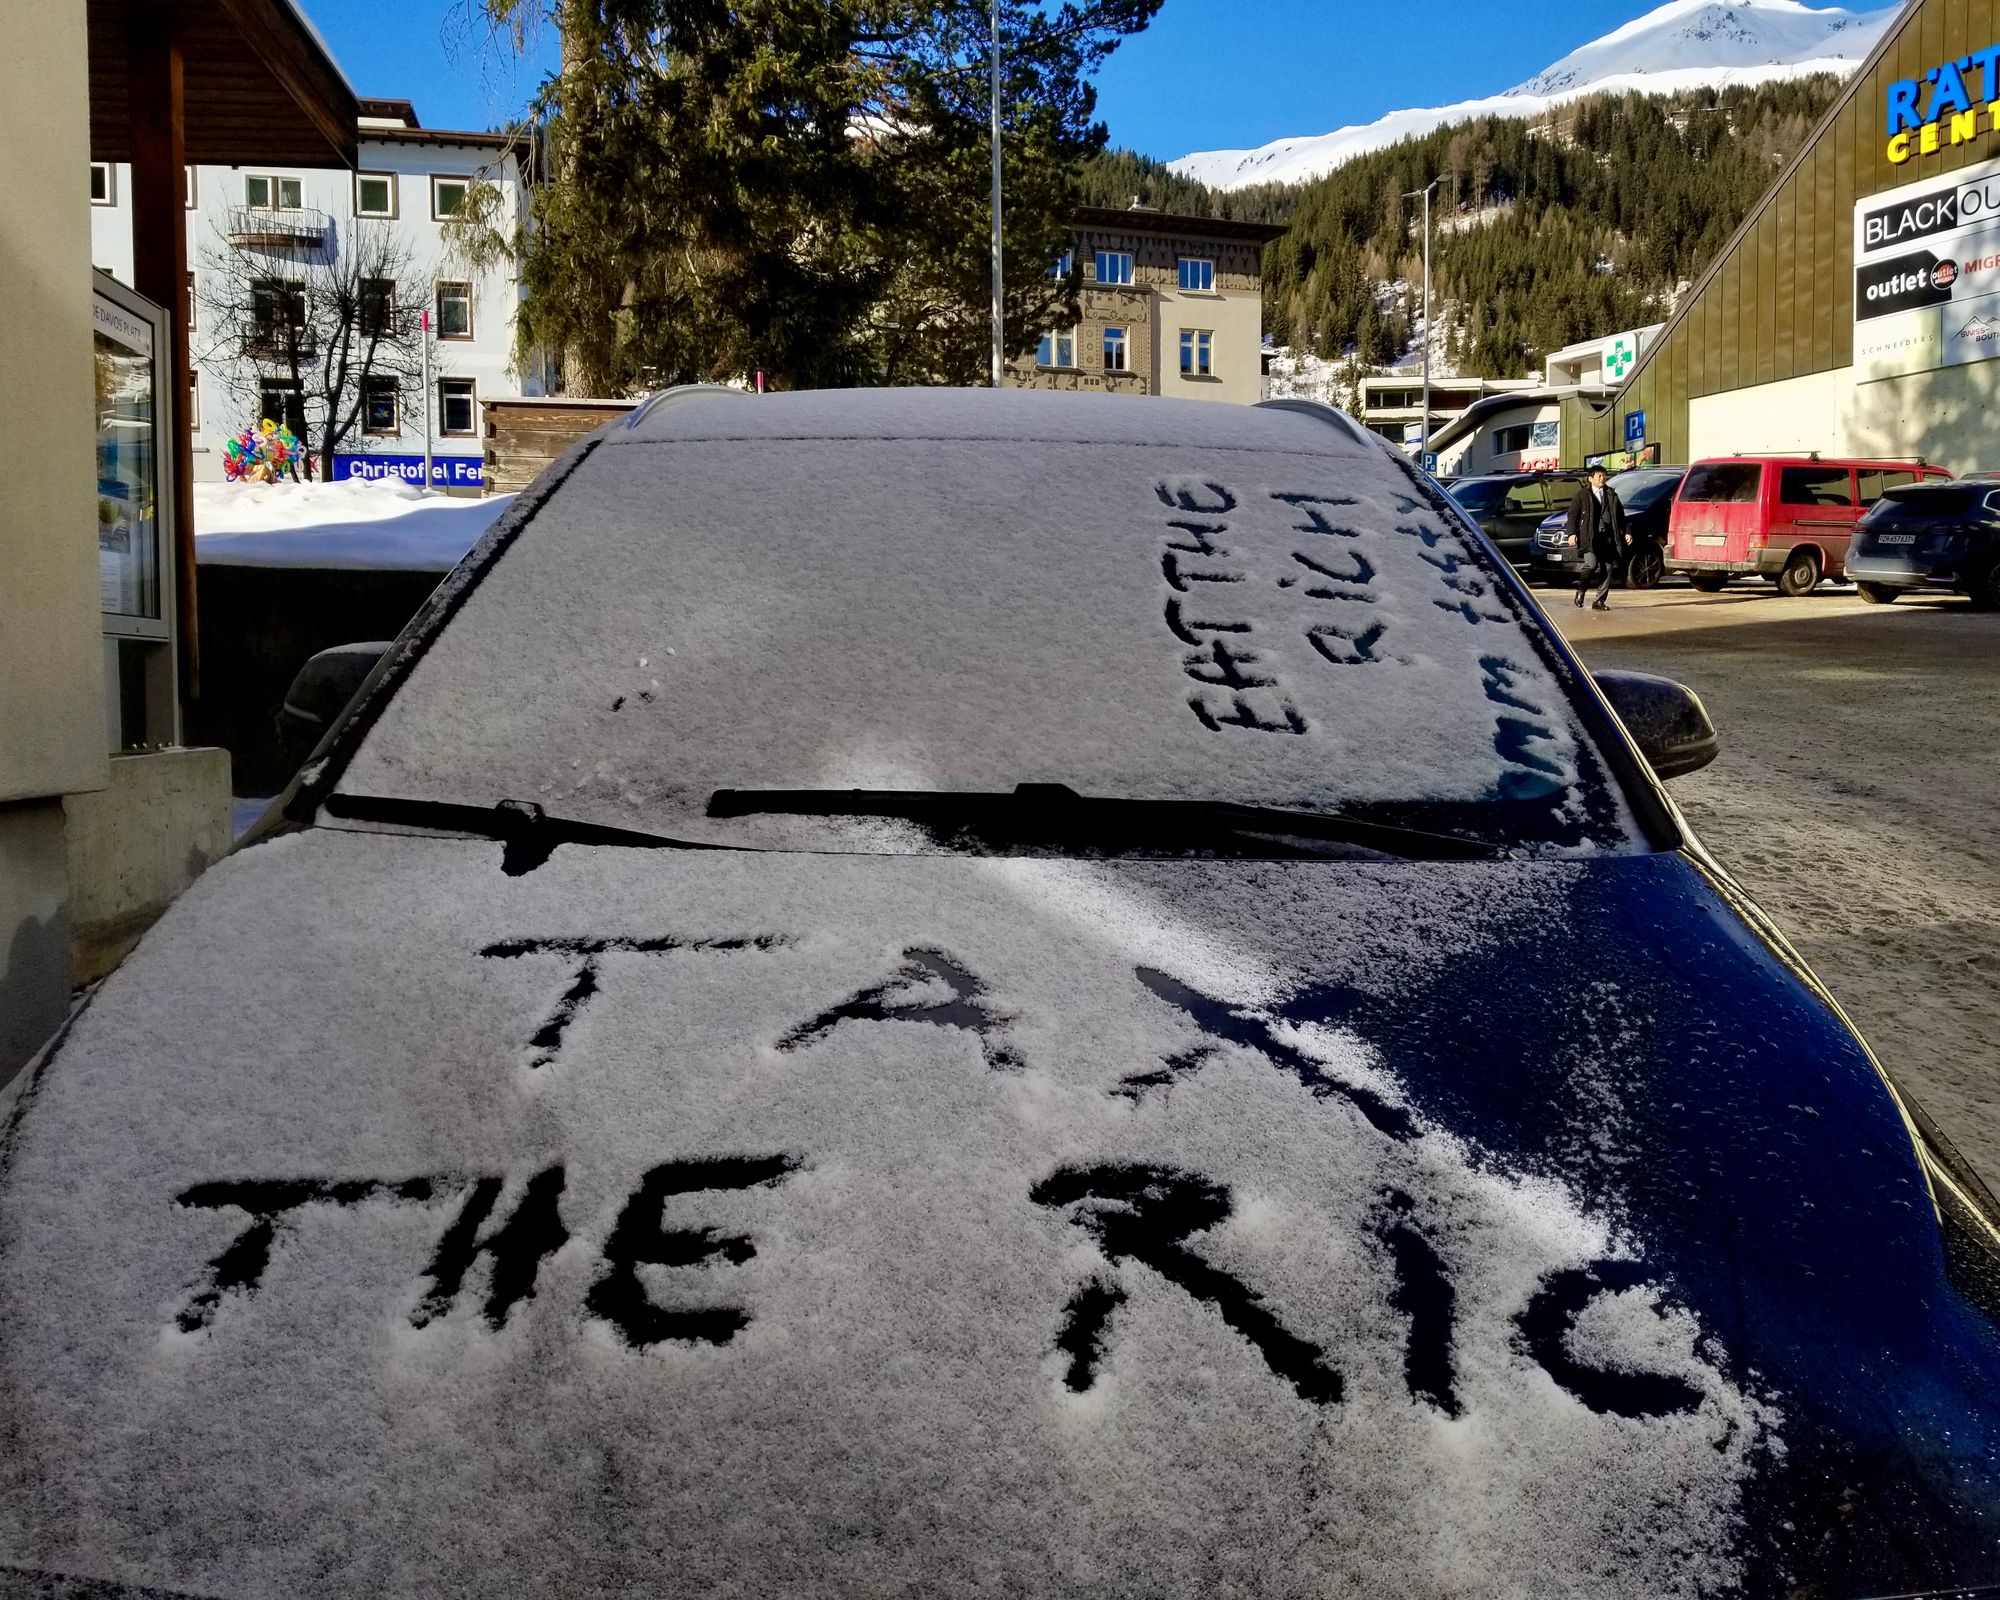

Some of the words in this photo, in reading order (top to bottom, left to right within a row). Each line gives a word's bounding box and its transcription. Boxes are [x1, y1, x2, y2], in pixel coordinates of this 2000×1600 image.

[1887, 44, 2000, 136] RÄT
[1866, 267, 1926, 300] outlet
[100, 308, 122, 332] DAVOS
[123, 321, 141, 342] PLATZ
[1862, 334, 1934, 356] SCHNEIDERS
[1629, 416, 1639, 437] P
[350, 461, 448, 479] Christofel
[479, 935, 1420, 1138] TAX
[175, 1155, 802, 1345] THE
